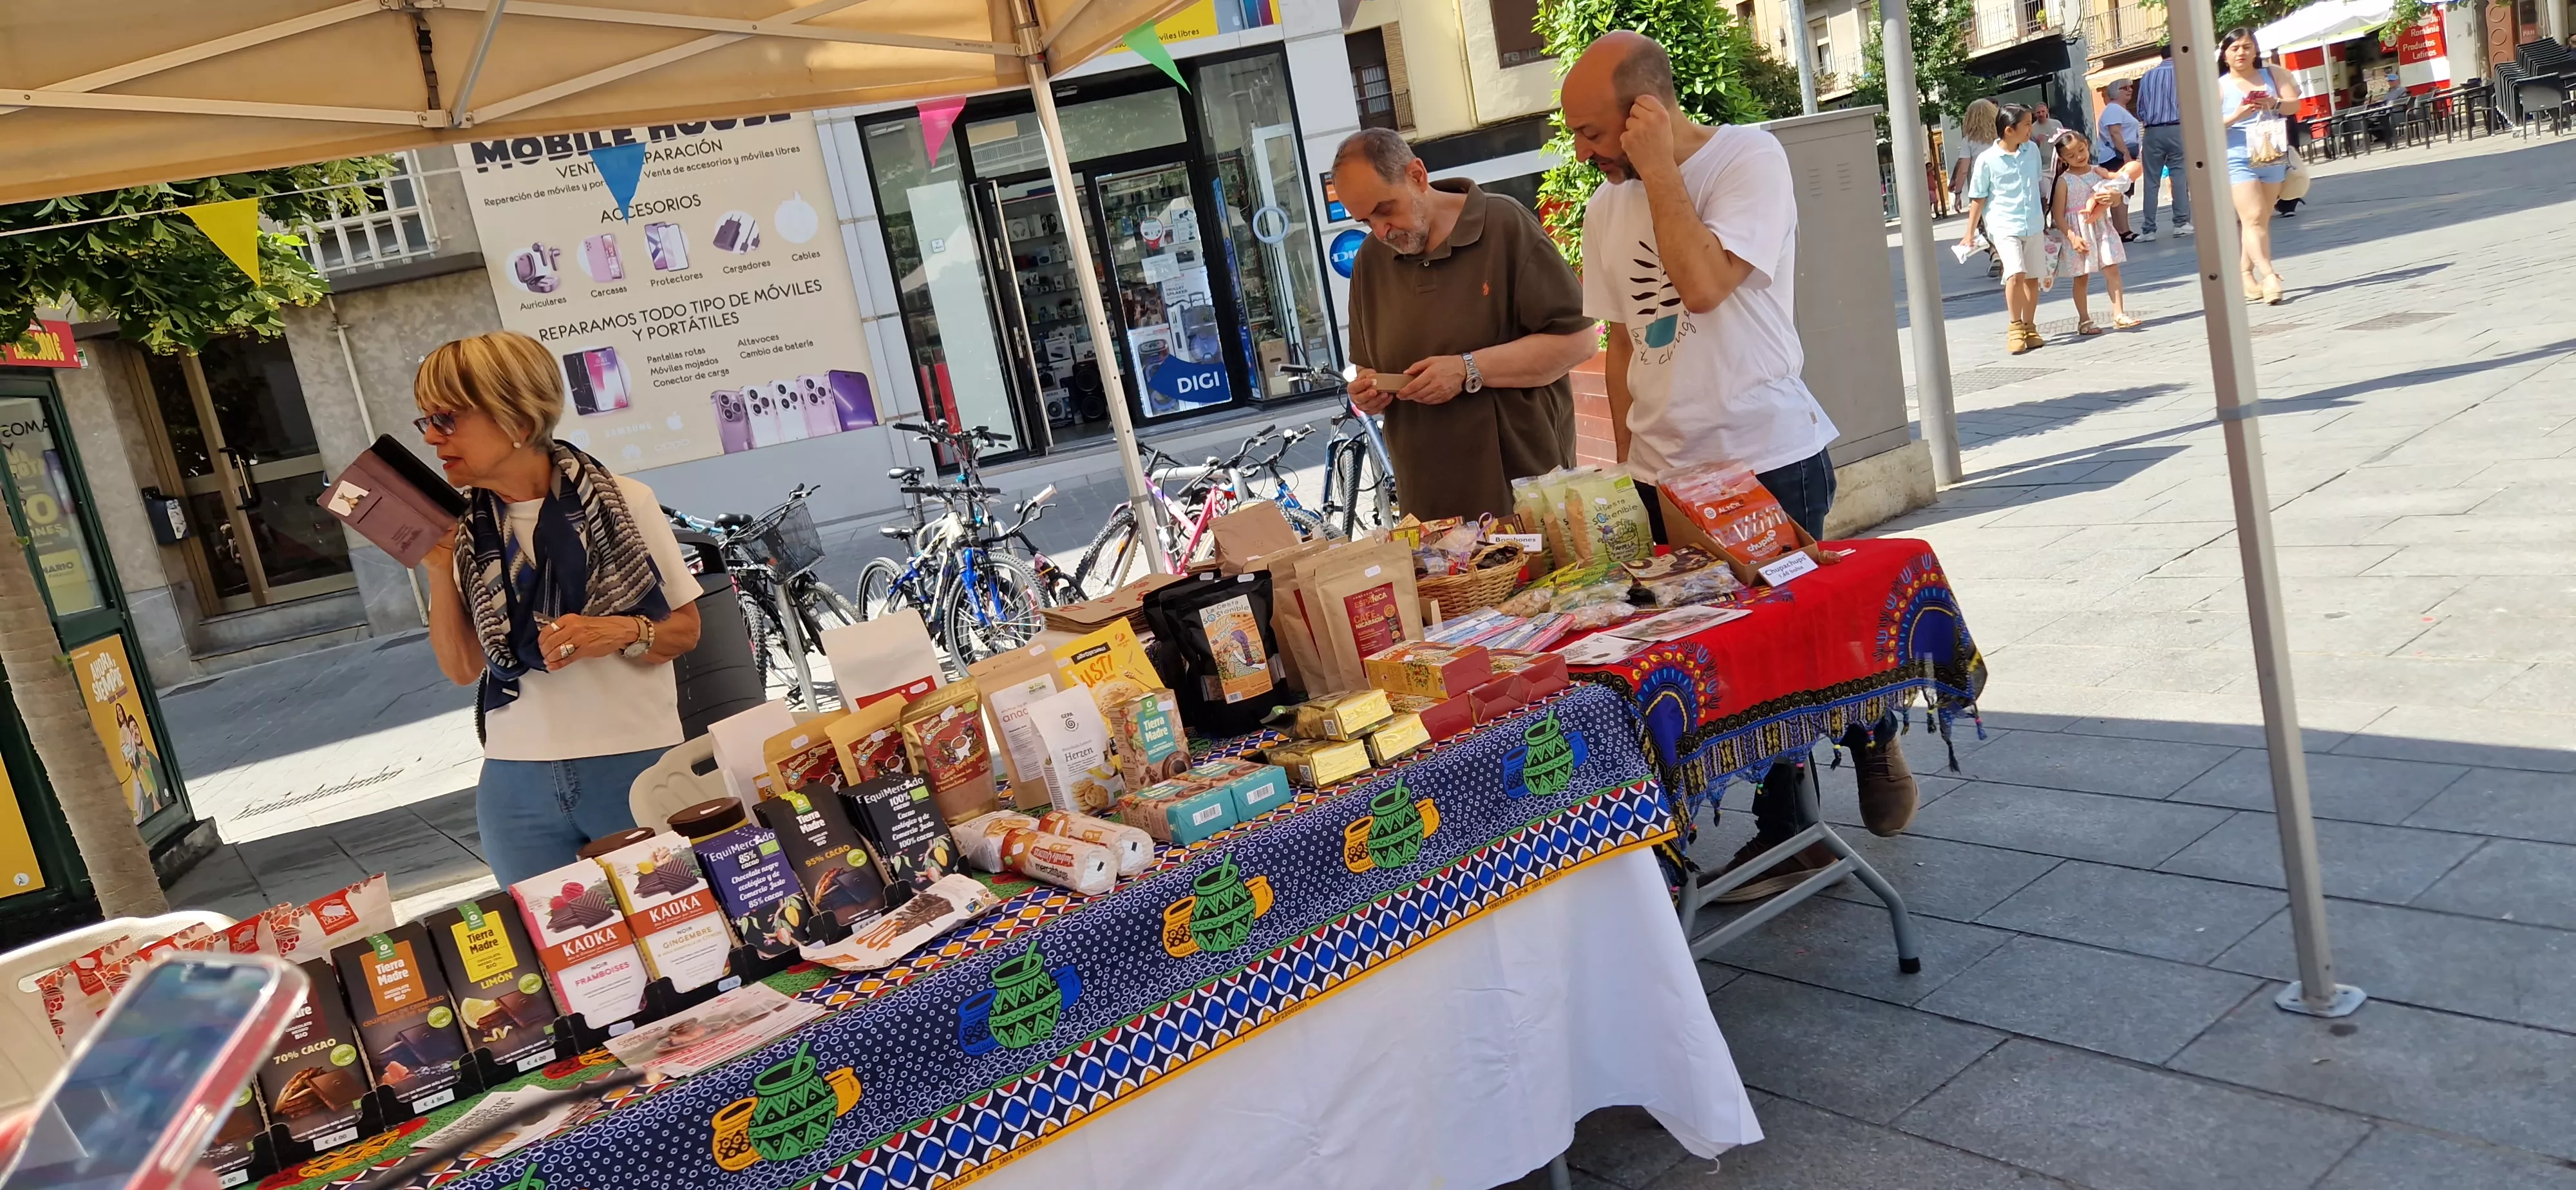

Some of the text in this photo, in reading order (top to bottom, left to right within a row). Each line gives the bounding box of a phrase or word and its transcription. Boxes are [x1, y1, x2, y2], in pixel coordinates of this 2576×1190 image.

[1178, 27, 1200, 38] libres
[2410, 24, 2439, 37] România
[2403, 39, 2436, 52] Productos
[2412, 49, 2437, 60] Latinos
[555, 138, 723, 179] VENT PARACIÓN
[643, 146, 800, 178] Venta de accesorios y móviles libres
[484, 183, 587, 207] Reparación de móviles y
[600, 194, 702, 223] ACCESORIOS
[791, 250, 821, 261] Cables
[723, 260, 771, 274] Cargadores
[650, 272, 703, 287] Protectores
[591, 285, 628, 298] Carcasas
[520, 296, 567, 312] Auriculares
[539, 279, 822, 342] REPARAMOS TODO TIPO DE MÓVILES
[632, 311, 740, 343] Y PORTÁTILES
[737, 334, 780, 348] Altavoces
[739, 339, 814, 359] Cambio de batería
[647, 346, 706, 364] Pantallas rotas
[650, 357, 719, 376] Móviles mojados
[653, 368, 730, 388] Conector de carga
[1177, 371, 1220, 393] DIGI
[1355, 615, 1385, 630] NICARAGUA
[1061, 712, 1074, 720] GEPA
[1142, 716, 1165, 732] Tierra
[1144, 726, 1169, 742] Madre
[1064, 746, 1094, 762] Herzen
[889, 791, 911, 808] 100%
[893, 801, 911, 812] cacao
[796, 811, 821, 825] Tierra
[897, 809, 916, 820] Cacao
[799, 818, 826, 835] Madre
[891, 818, 918, 832] ecológico
[892, 820, 934, 841] Comercio Justo
[899, 831, 934, 849] 100% cacao
[738, 849, 757, 864] 85%
[741, 858, 760, 869] cacao
[805, 844, 851, 867] 95% CACAO
[731, 862, 779, 885] Chocolate negro
[738, 876, 766, 892] ecológico
[739, 878, 786, 901] Comercio Justo
[748, 890, 784, 909] 85% cacao
[1488, 894, 1515, 911] VERITABLE
[649, 895, 701, 923] KAOKA
[466, 929, 495, 944] Tierra
[663, 927, 713, 949] GINGEMBRE
[676, 926, 693, 936] NOIR
[469, 938, 500, 955] Madre
[562, 927, 618, 957] KAOKA
[375, 959, 405, 975] Tierra
[486, 962, 498, 970] BIO
[574, 961, 630, 987] FRAMBOISES
[591, 961, 609, 971] NOIR
[377, 968, 410, 987] Madre
[480, 971, 514, 990] LIMÓN
[393, 994, 407, 1002] BIO
[294, 1032, 308, 1041] BIO
[272, 1037, 337, 1066] 70% CACAO
[998, 1153, 1014, 1166] JAVA
[1018, 1139, 1043, 1155] PRINTS
